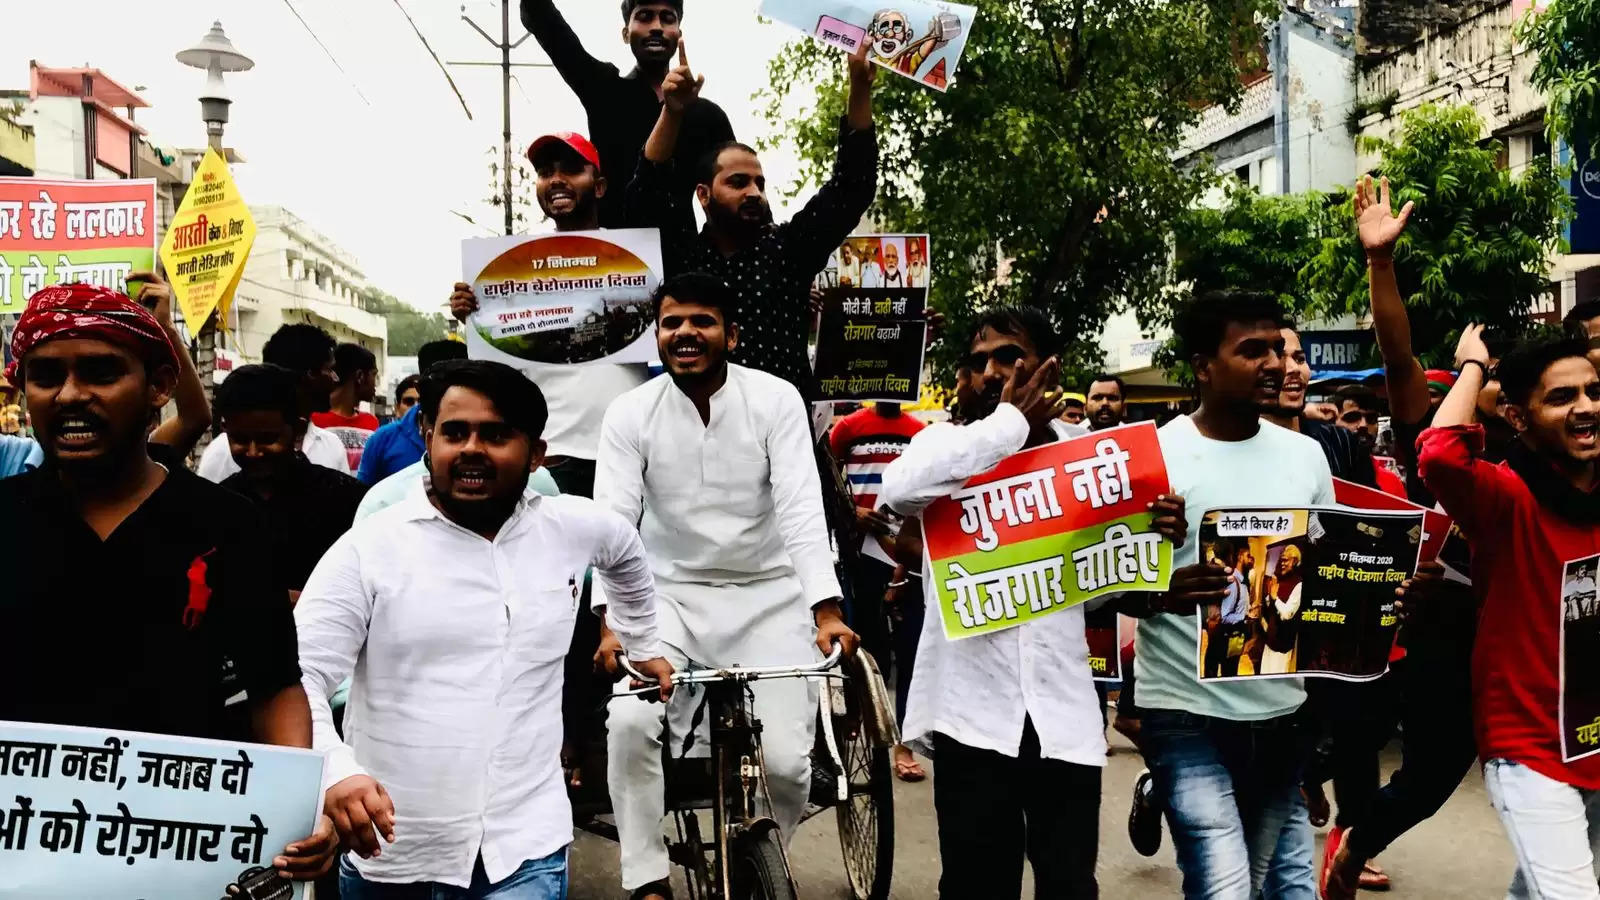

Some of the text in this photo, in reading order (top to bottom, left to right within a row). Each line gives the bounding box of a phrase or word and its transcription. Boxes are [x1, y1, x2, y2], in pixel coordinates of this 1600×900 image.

[822, 28, 840, 43] जुमला
[28, 190, 58, 240] रहे
[64, 200, 147, 240] ललकार
[173, 214, 208, 250] आरती
[176, 256, 198, 276] आरती
[531, 255, 598, 270] 17 सितम्बर
[20, 254, 48, 301] दो
[483, 280, 529, 298] राष्ट्रीय
[608, 273, 647, 289] दिवस
[519, 309, 532, 319] रहे
[534, 306, 574, 318] ललकार
[842, 297, 860, 315] मोदी
[860, 296, 873, 316] जी,
[892, 297, 908, 315] नहीं
[527, 320, 536, 330] दो
[538, 317, 570, 329] रोजगार
[844, 319, 877, 341] रोजगार
[820, 373, 911, 396] राष्ट्रीय बेरोजगार दिवस
[951, 437, 1133, 553] जुमला नही
[1221, 515, 1289, 532] नौकरी किधर है?
[1339, 551, 1394, 565] 17 सितम्बर 2020
[945, 523, 1163, 629] रोजगार चाहिए
[1317, 564, 1407, 583] राष्ट्रीय बेरोजगार दिवस
[1301, 608, 1346, 625] मोदी सरकार
[61, 736, 130, 790] नहीं,
[136, 750, 217, 792] जवाब
[221, 749, 254, 796] दो
[39, 798, 91, 854] को
[96, 801, 226, 866] रोज़गार
[231, 813, 268, 865] दो
